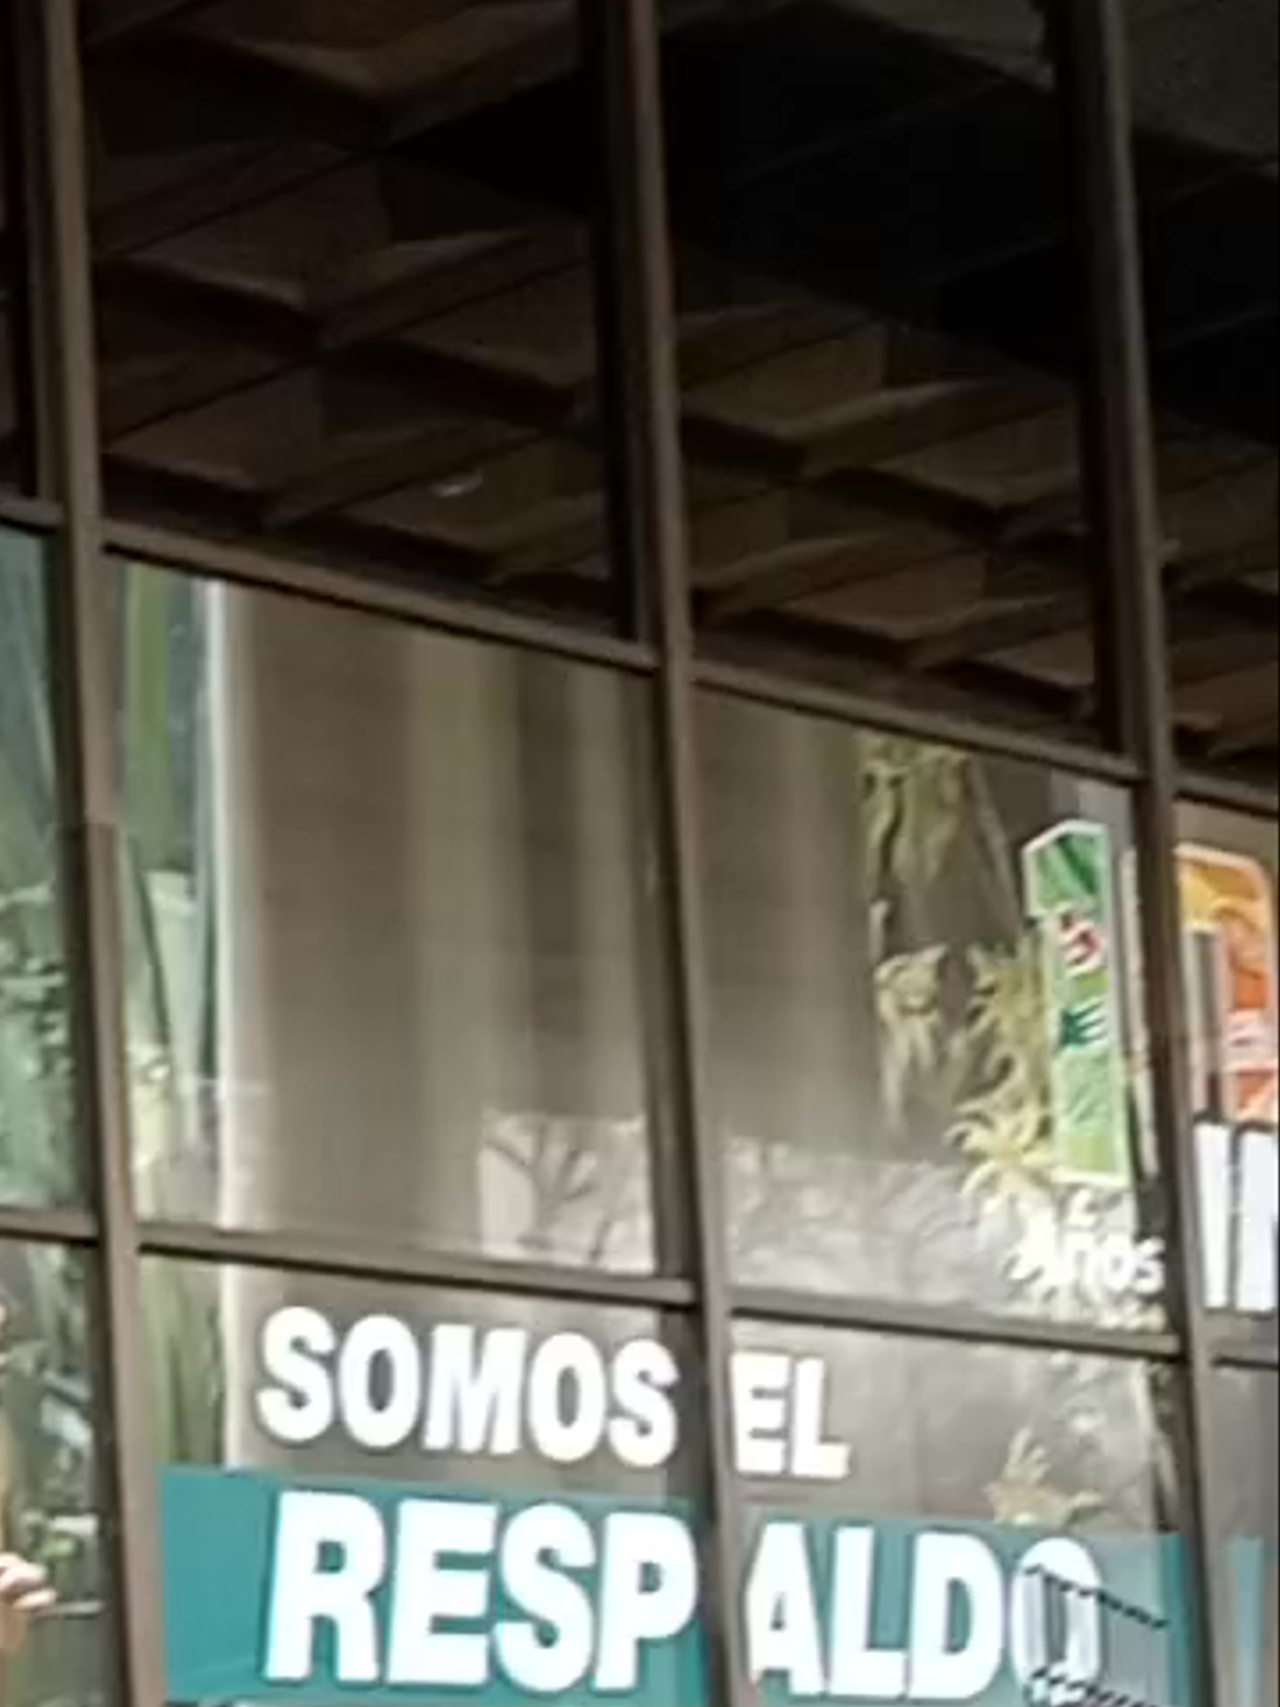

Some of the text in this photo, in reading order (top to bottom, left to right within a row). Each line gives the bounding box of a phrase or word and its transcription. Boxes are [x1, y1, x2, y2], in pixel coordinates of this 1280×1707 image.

[257, 1305, 848, 1477] SOMOS EL
[264, 1491, 1104, 1704] RESPALDO
